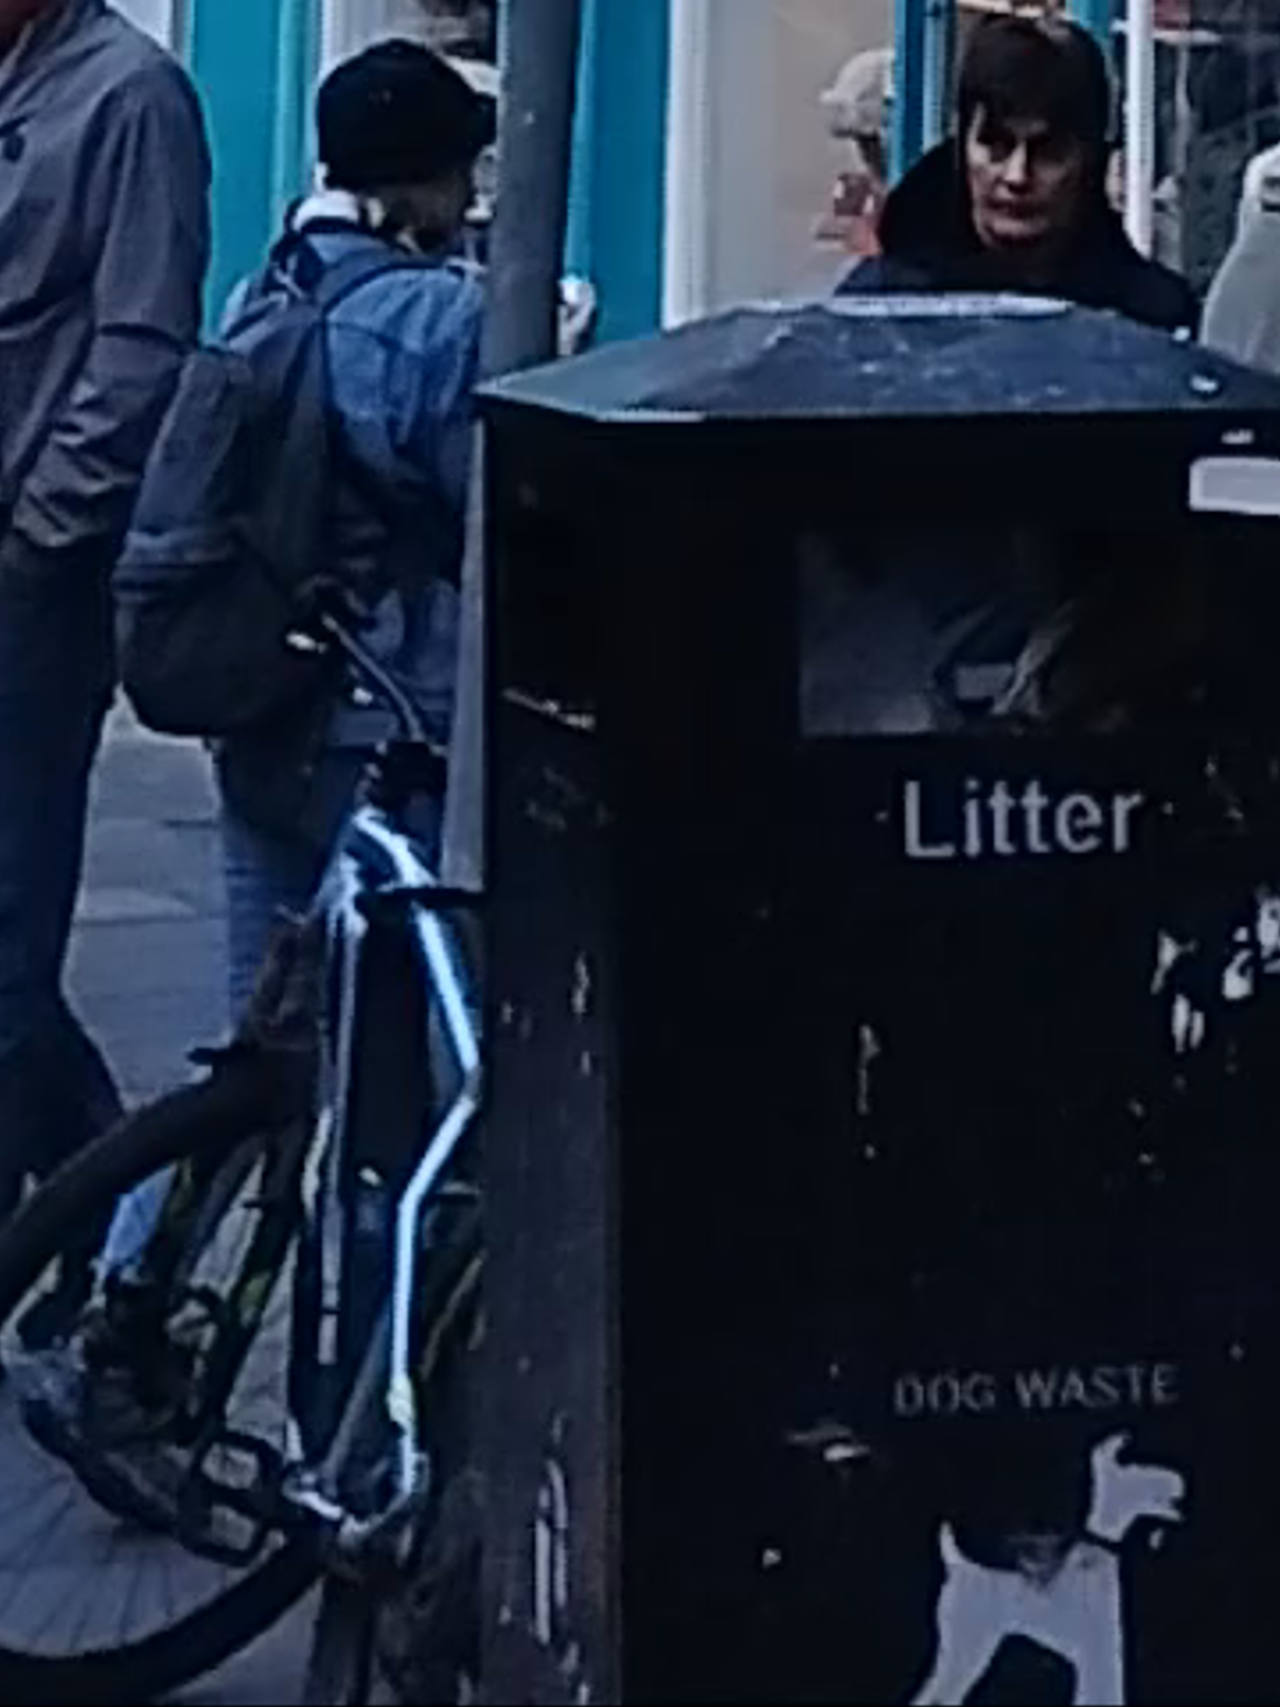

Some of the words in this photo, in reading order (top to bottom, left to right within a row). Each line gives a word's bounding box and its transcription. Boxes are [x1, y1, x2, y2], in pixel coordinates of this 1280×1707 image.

[904, 777, 1144, 858] Litter
[893, 1371, 996, 1416] DOG
[1014, 1362, 1180, 1410] WASTE
